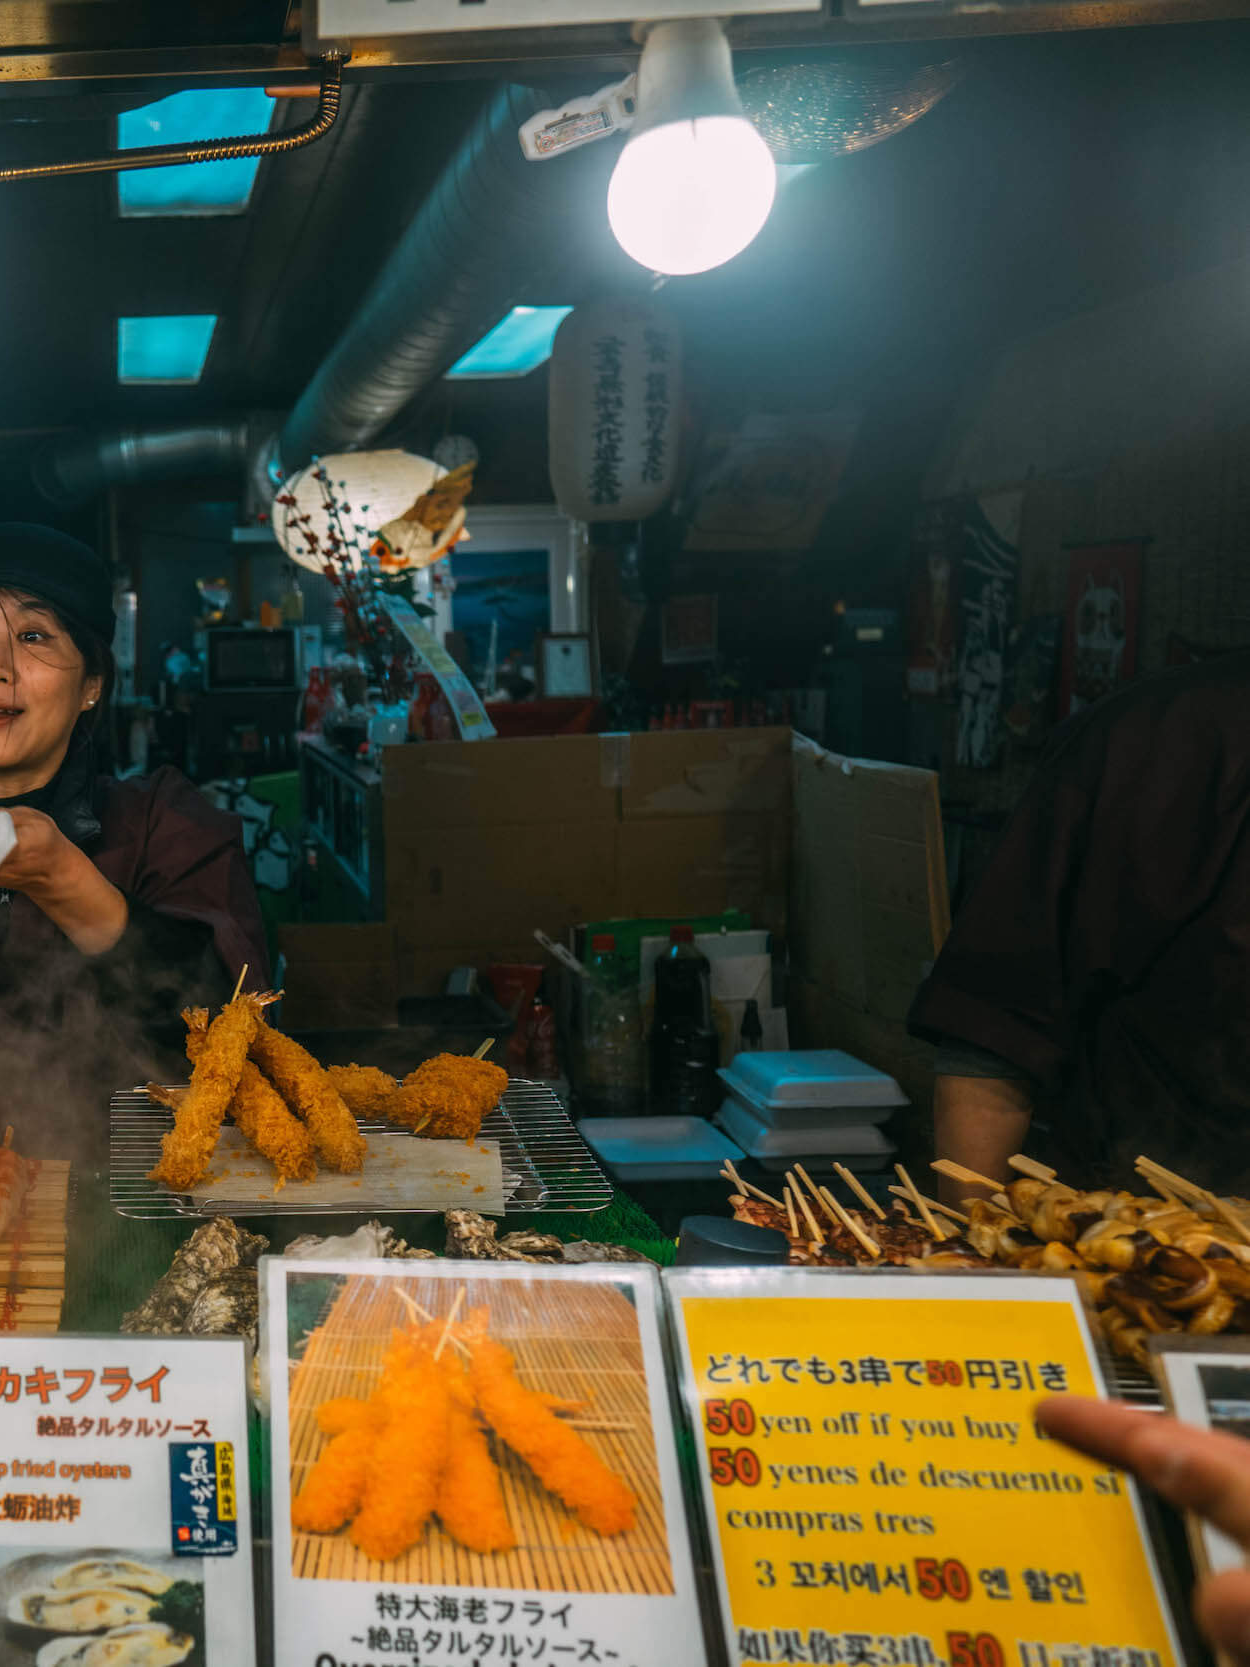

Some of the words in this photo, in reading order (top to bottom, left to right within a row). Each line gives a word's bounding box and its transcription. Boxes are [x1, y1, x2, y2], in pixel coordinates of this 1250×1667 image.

[706, 1353, 1068, 1392] どれでも3串で50円引き
[36, 1415, 212, 1438] 絶品タルタルソース
[705, 1398, 756, 1437] 50
[761, 1413, 812, 1438] yen
[823, 1411, 859, 1436] off
[870, 1412, 891, 1436] if
[901, 1416, 955, 1442] you
[964, 1414, 1021, 1446] buy
[11, 1459, 56, 1479] fried
[59, 1462, 132, 1483] oysters
[708, 1446, 762, 1487] 50
[767, 1461, 858, 1489] yenes
[870, 1460, 908, 1488] de
[918, 1461, 1083, 1495] descuento
[726, 1506, 864, 1539] compras
[875, 1509, 936, 1537] tres
[756, 1559, 776, 1588] 3
[1024, 1567, 1087, 1604] 할인
[375, 1592, 574, 1629] 特大海老フライ
